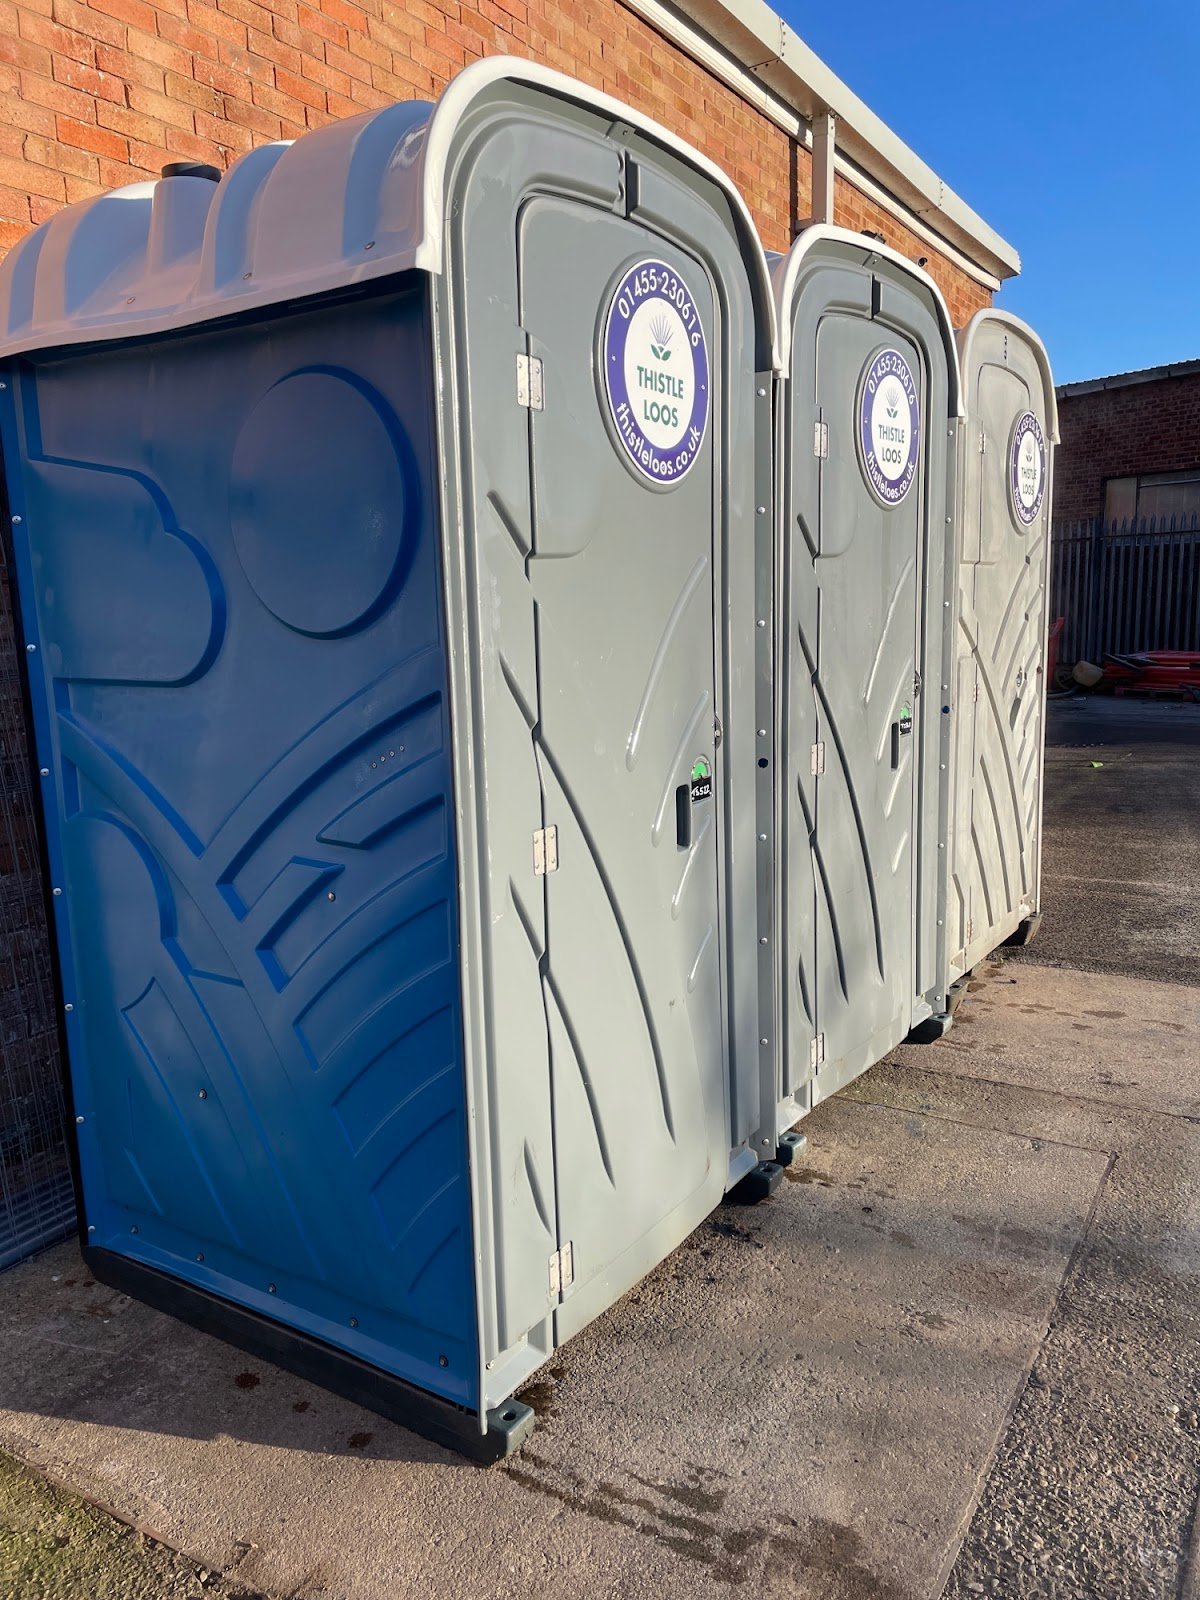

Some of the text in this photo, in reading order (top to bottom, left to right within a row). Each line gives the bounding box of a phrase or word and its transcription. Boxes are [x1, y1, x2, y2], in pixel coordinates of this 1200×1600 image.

[636, 365, 684, 400] THISTLE
[643, 399, 679, 428] LOOS
[616, 402, 701, 476] thistleloos.co.uk
[878, 424, 905, 444] THISTLE
[881, 448, 902, 465] LOOS
[867, 451, 914, 499] thistleloos.co.uk
[1021, 466, 1037, 480] THISTLE
[1022, 484, 1035, 496] LOOS
